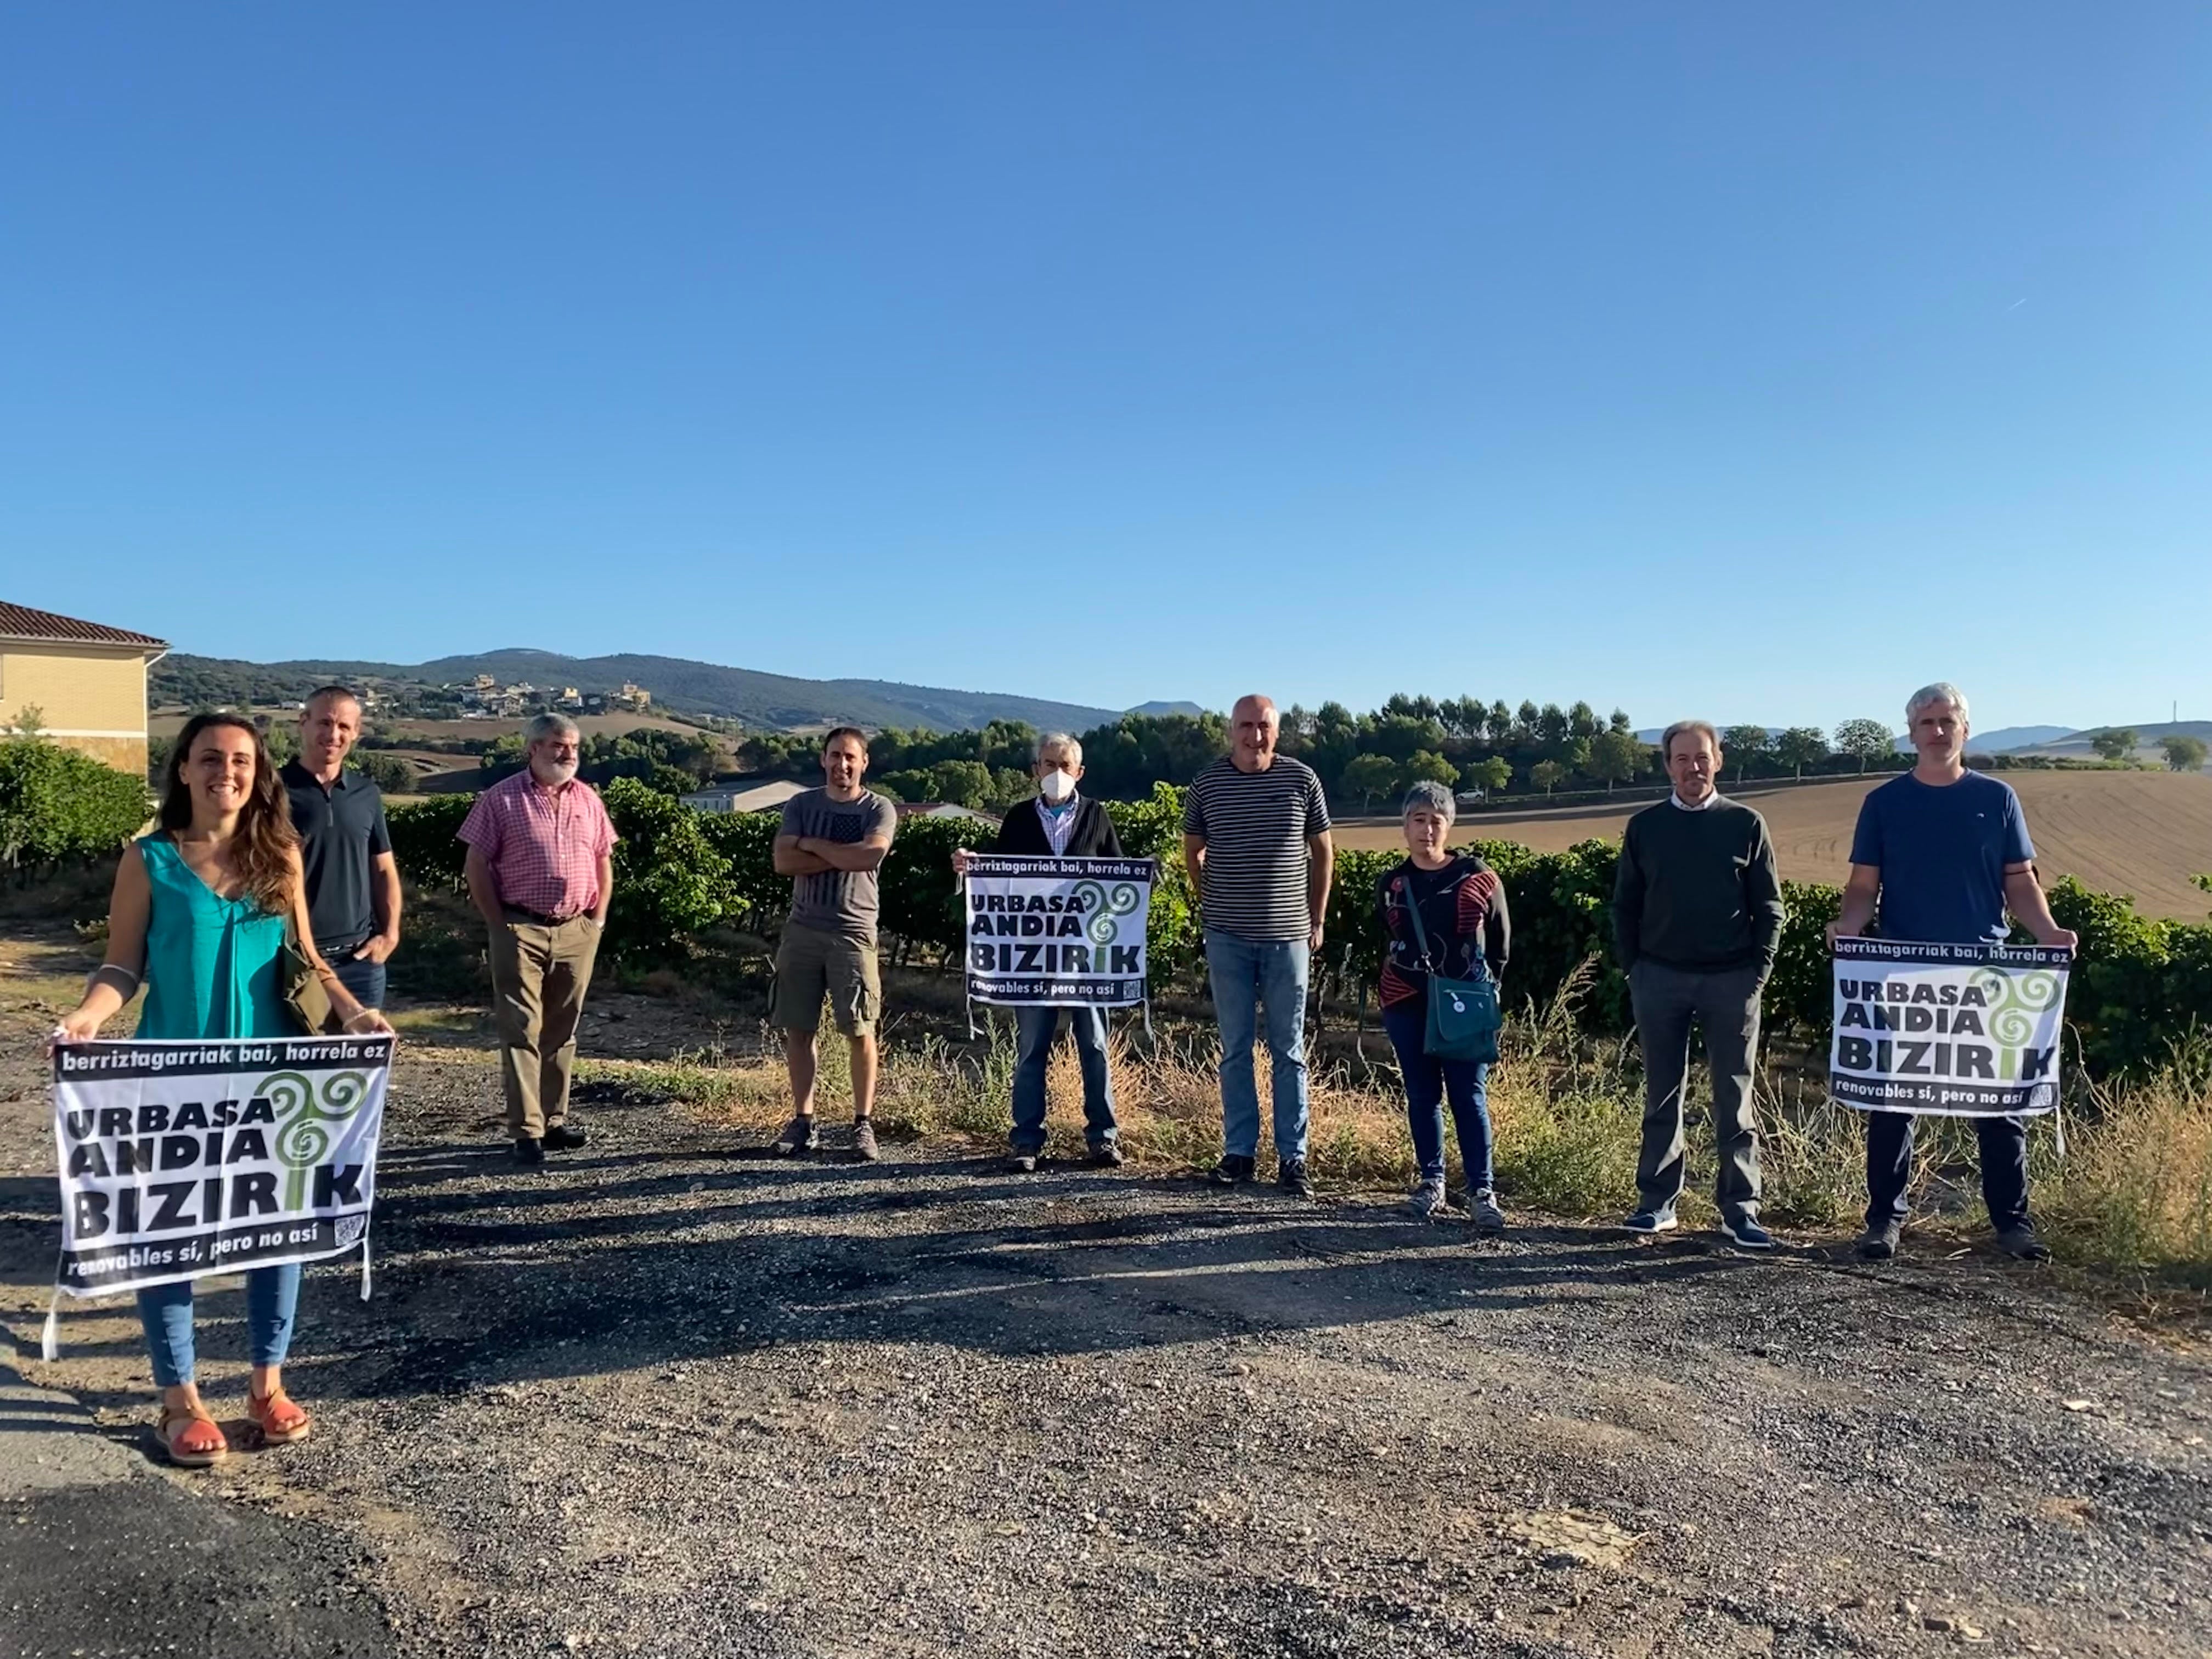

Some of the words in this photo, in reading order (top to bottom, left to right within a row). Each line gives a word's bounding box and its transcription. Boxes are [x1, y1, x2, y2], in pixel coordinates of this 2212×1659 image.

[966, 859, 1058, 874] berriztagarriak
[1060, 862, 1084, 874] bai,
[1087, 861, 1131, 875] horrela
[1134, 866, 1147, 875] ez
[971, 894, 1086, 913] URBASA
[971, 914, 1082, 938] ANDIA
[1835, 940, 1950, 958] berriztagarriak
[1954, 945, 1984, 961] bai,
[1989, 945, 2046, 962] horrela
[2052, 952, 2069, 964] ez
[1033, 981, 1048, 995] sí,
[1051, 984, 1076, 996] pero
[1079, 985, 1094, 995] no
[1096, 982, 1115, 995] así
[1839, 979, 1987, 1007] URBASA
[1839, 1003, 1984, 1036] ANDIA
[63, 1045, 232, 1071] berriztagarriak
[238, 1045, 276, 1064] bai,
[285, 1042, 358, 1062] horrela
[363, 1044, 385, 1058] ez
[1835, 1077, 1914, 1099] renovables
[1918, 1085, 1936, 1102] sí,
[1940, 1090, 1976, 1104] pero
[1980, 1092, 1999, 1104] no
[2002, 1090, 2024, 1104] así
[66, 1098, 275, 1140] URBASA
[68, 1128, 269, 1178] ANDIA
[67, 1245, 173, 1277] renovables
[178, 1240, 204, 1261] sí,
[210, 1233, 252, 1257] pero
[258, 1231, 284, 1248] no
[288, 1224, 318, 1244] así
